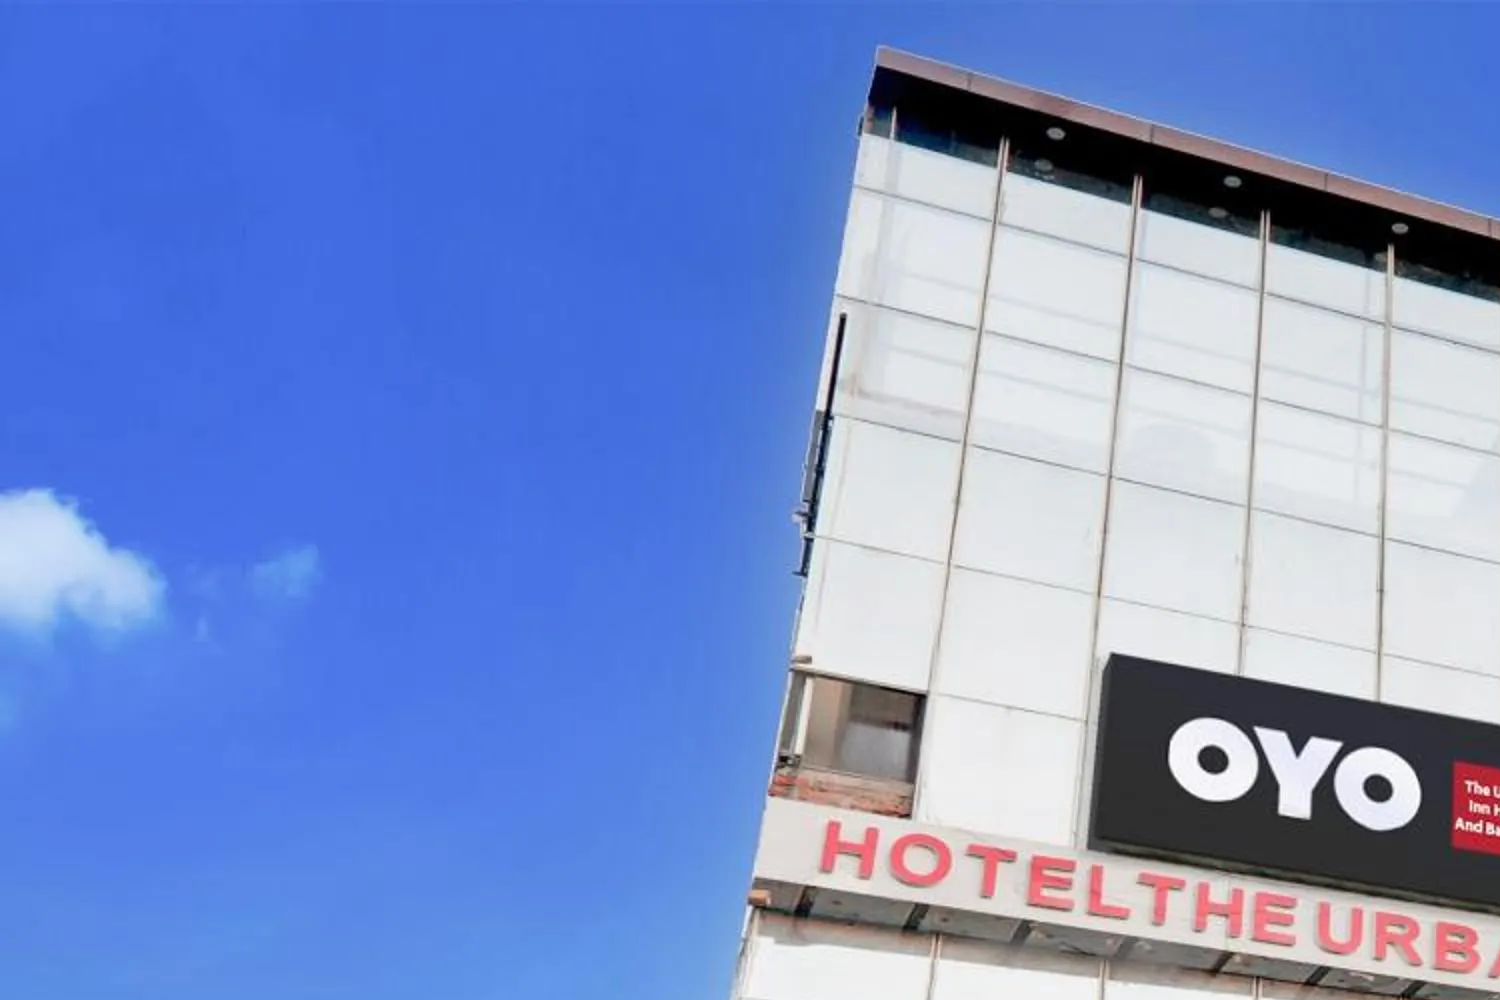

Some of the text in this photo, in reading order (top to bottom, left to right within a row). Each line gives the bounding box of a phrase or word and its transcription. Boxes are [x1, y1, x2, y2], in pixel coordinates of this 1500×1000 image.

[1169, 716, 1422, 832] OYO
[1464, 780, 1491, 797] The
[1469, 799, 1491, 815] Inn
[1455, 817, 1484, 834] And
